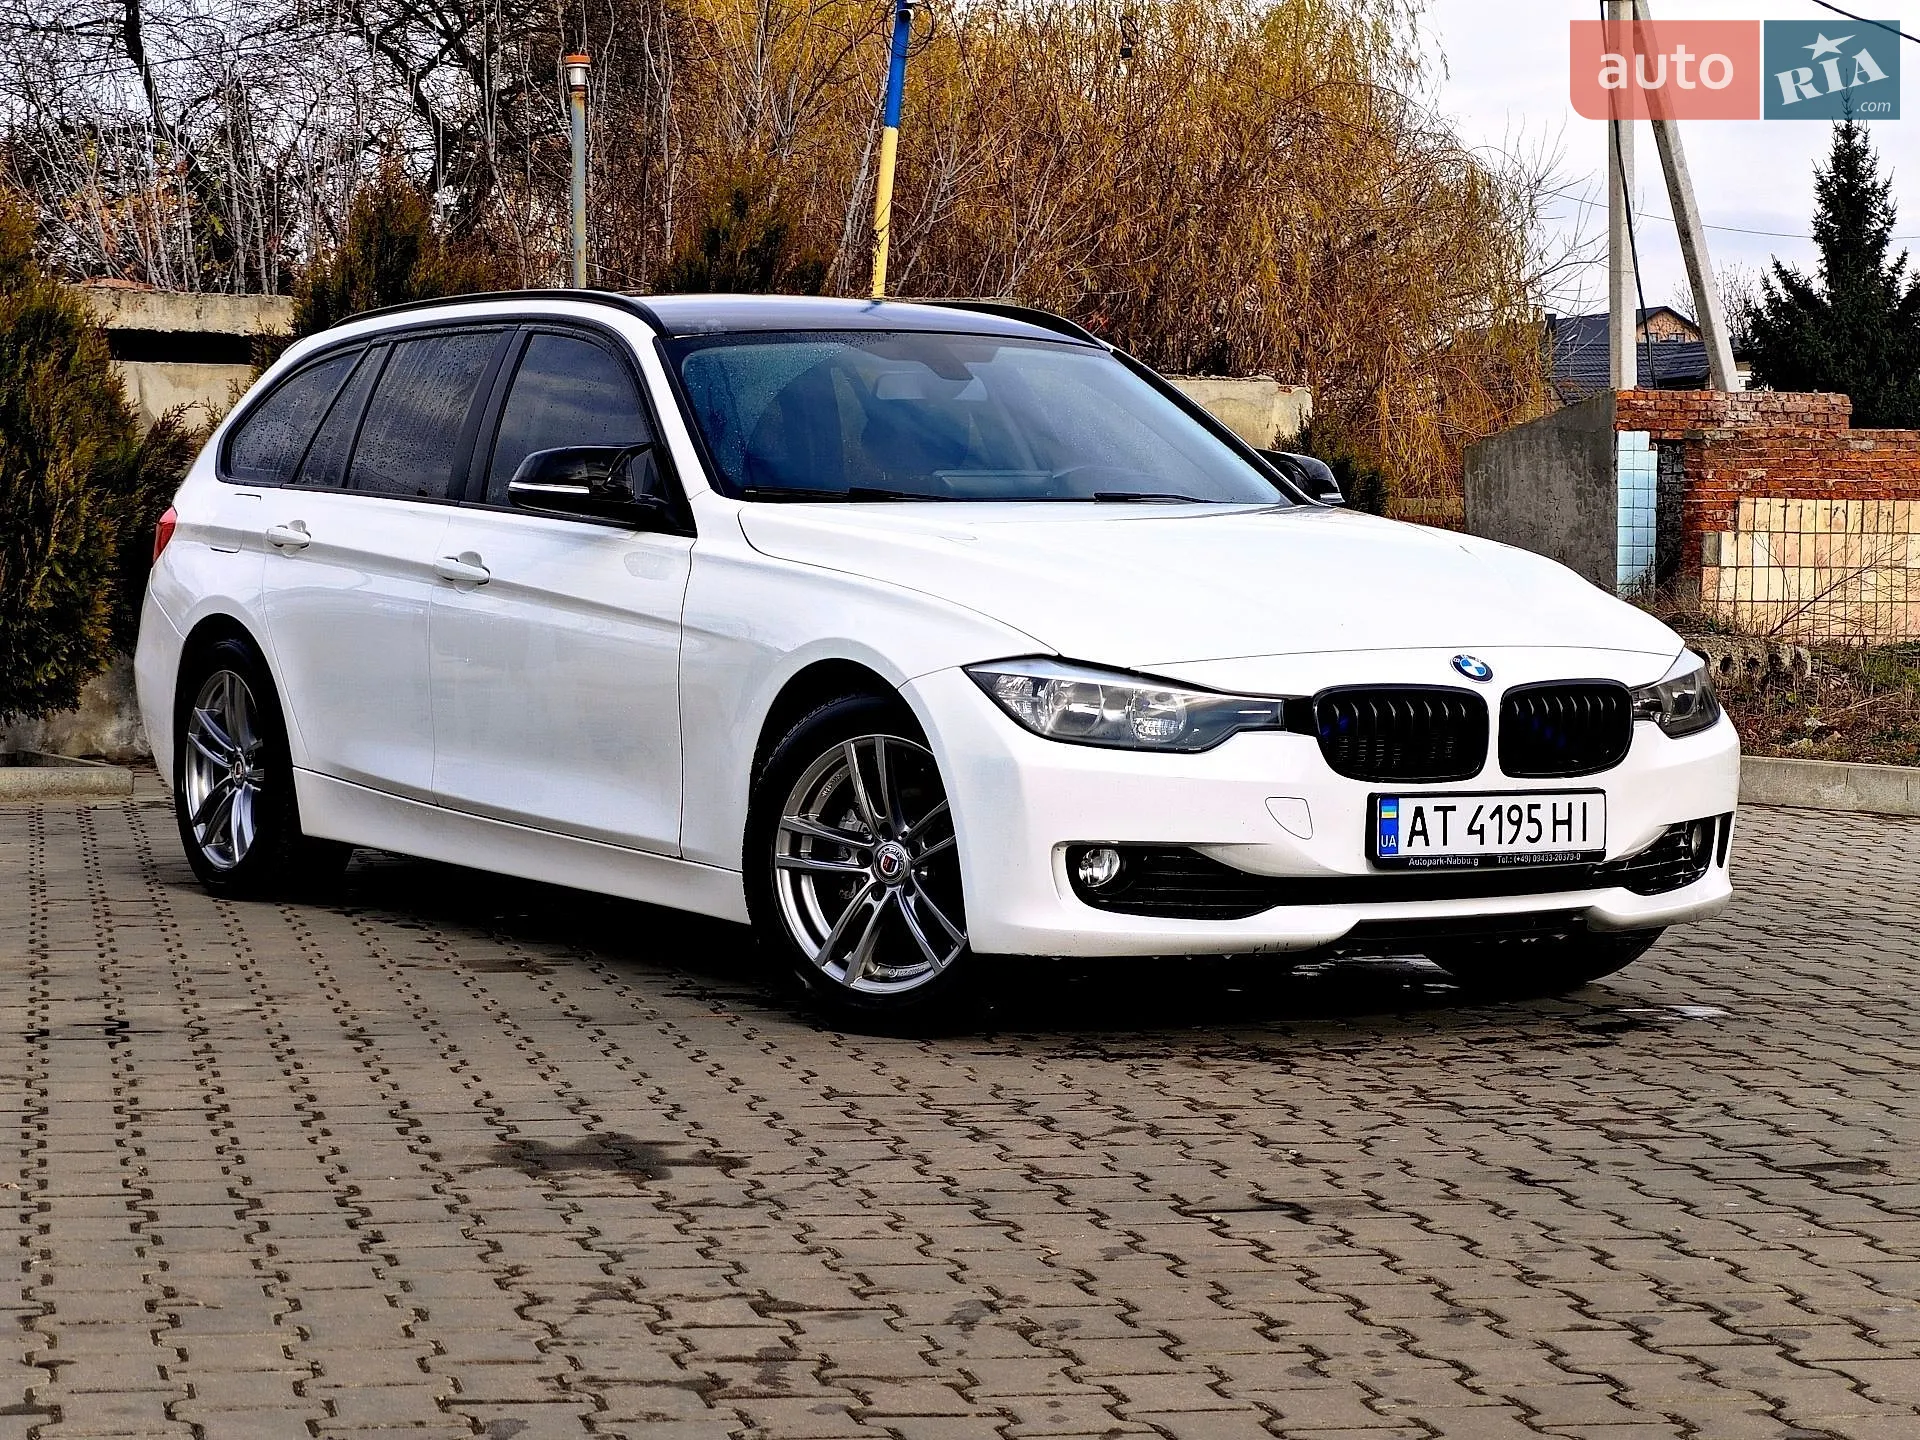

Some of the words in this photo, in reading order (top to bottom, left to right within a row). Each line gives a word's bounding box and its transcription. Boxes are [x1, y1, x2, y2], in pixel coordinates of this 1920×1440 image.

[1407, 805, 1457, 848] AT
[1467, 804, 1543, 846] 4195
[1552, 802, 1587, 843] HI
[1381, 834, 1397, 848] UA
